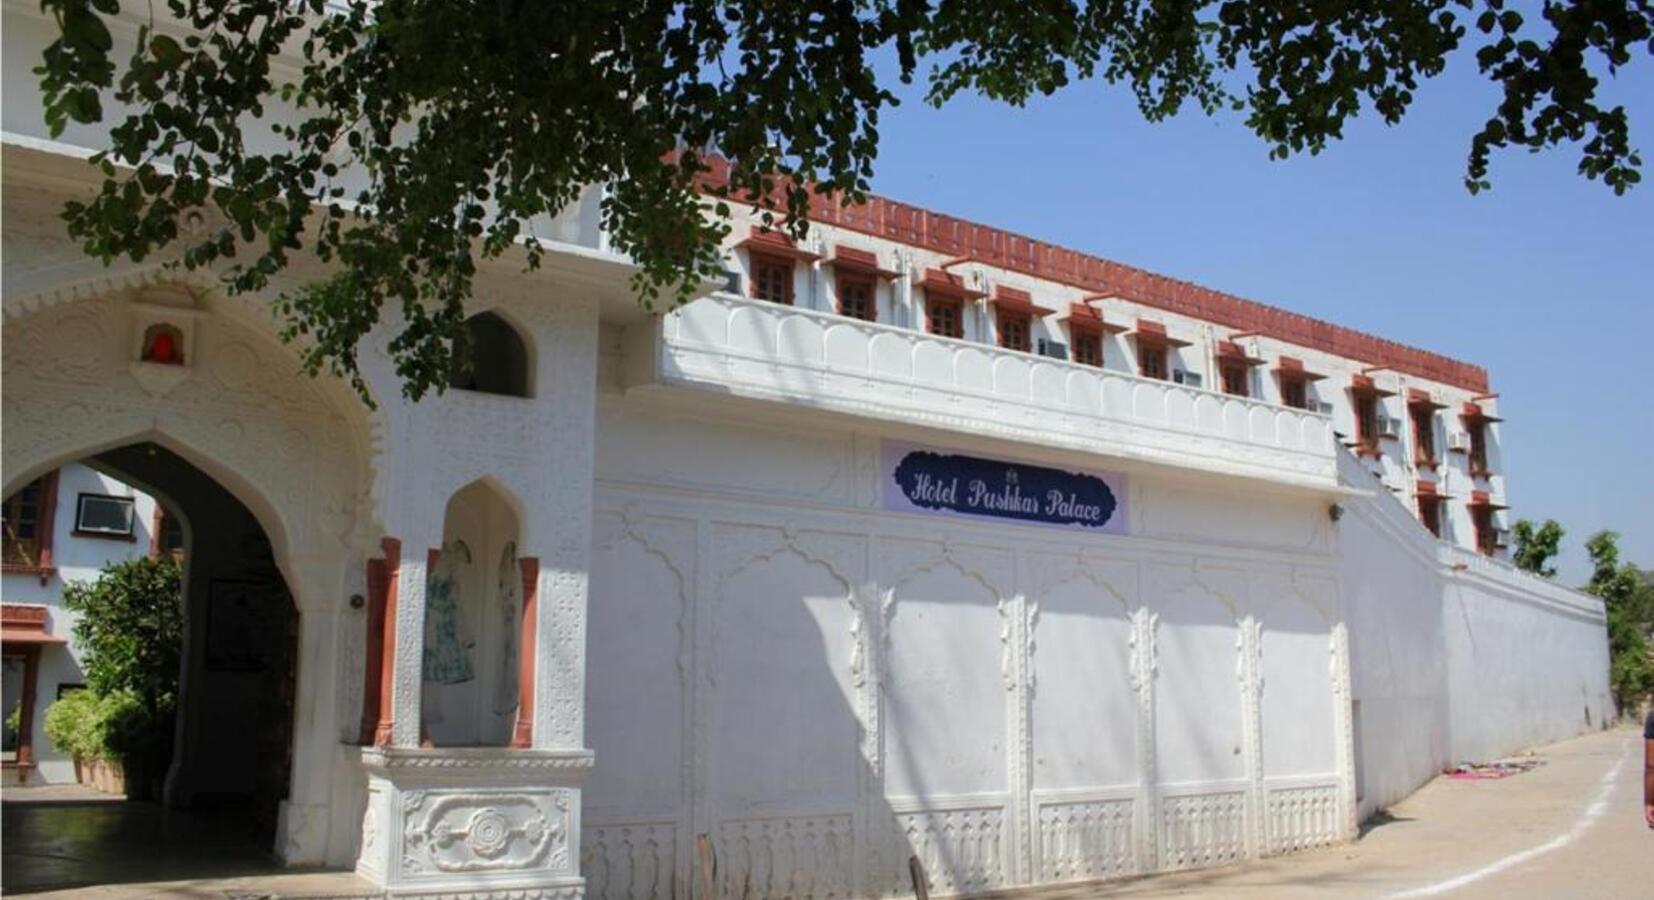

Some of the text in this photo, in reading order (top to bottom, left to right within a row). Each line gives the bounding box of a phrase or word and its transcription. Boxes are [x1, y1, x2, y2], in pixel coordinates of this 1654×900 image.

[911, 471, 1100, 521] Hotel Pushkar Palace
